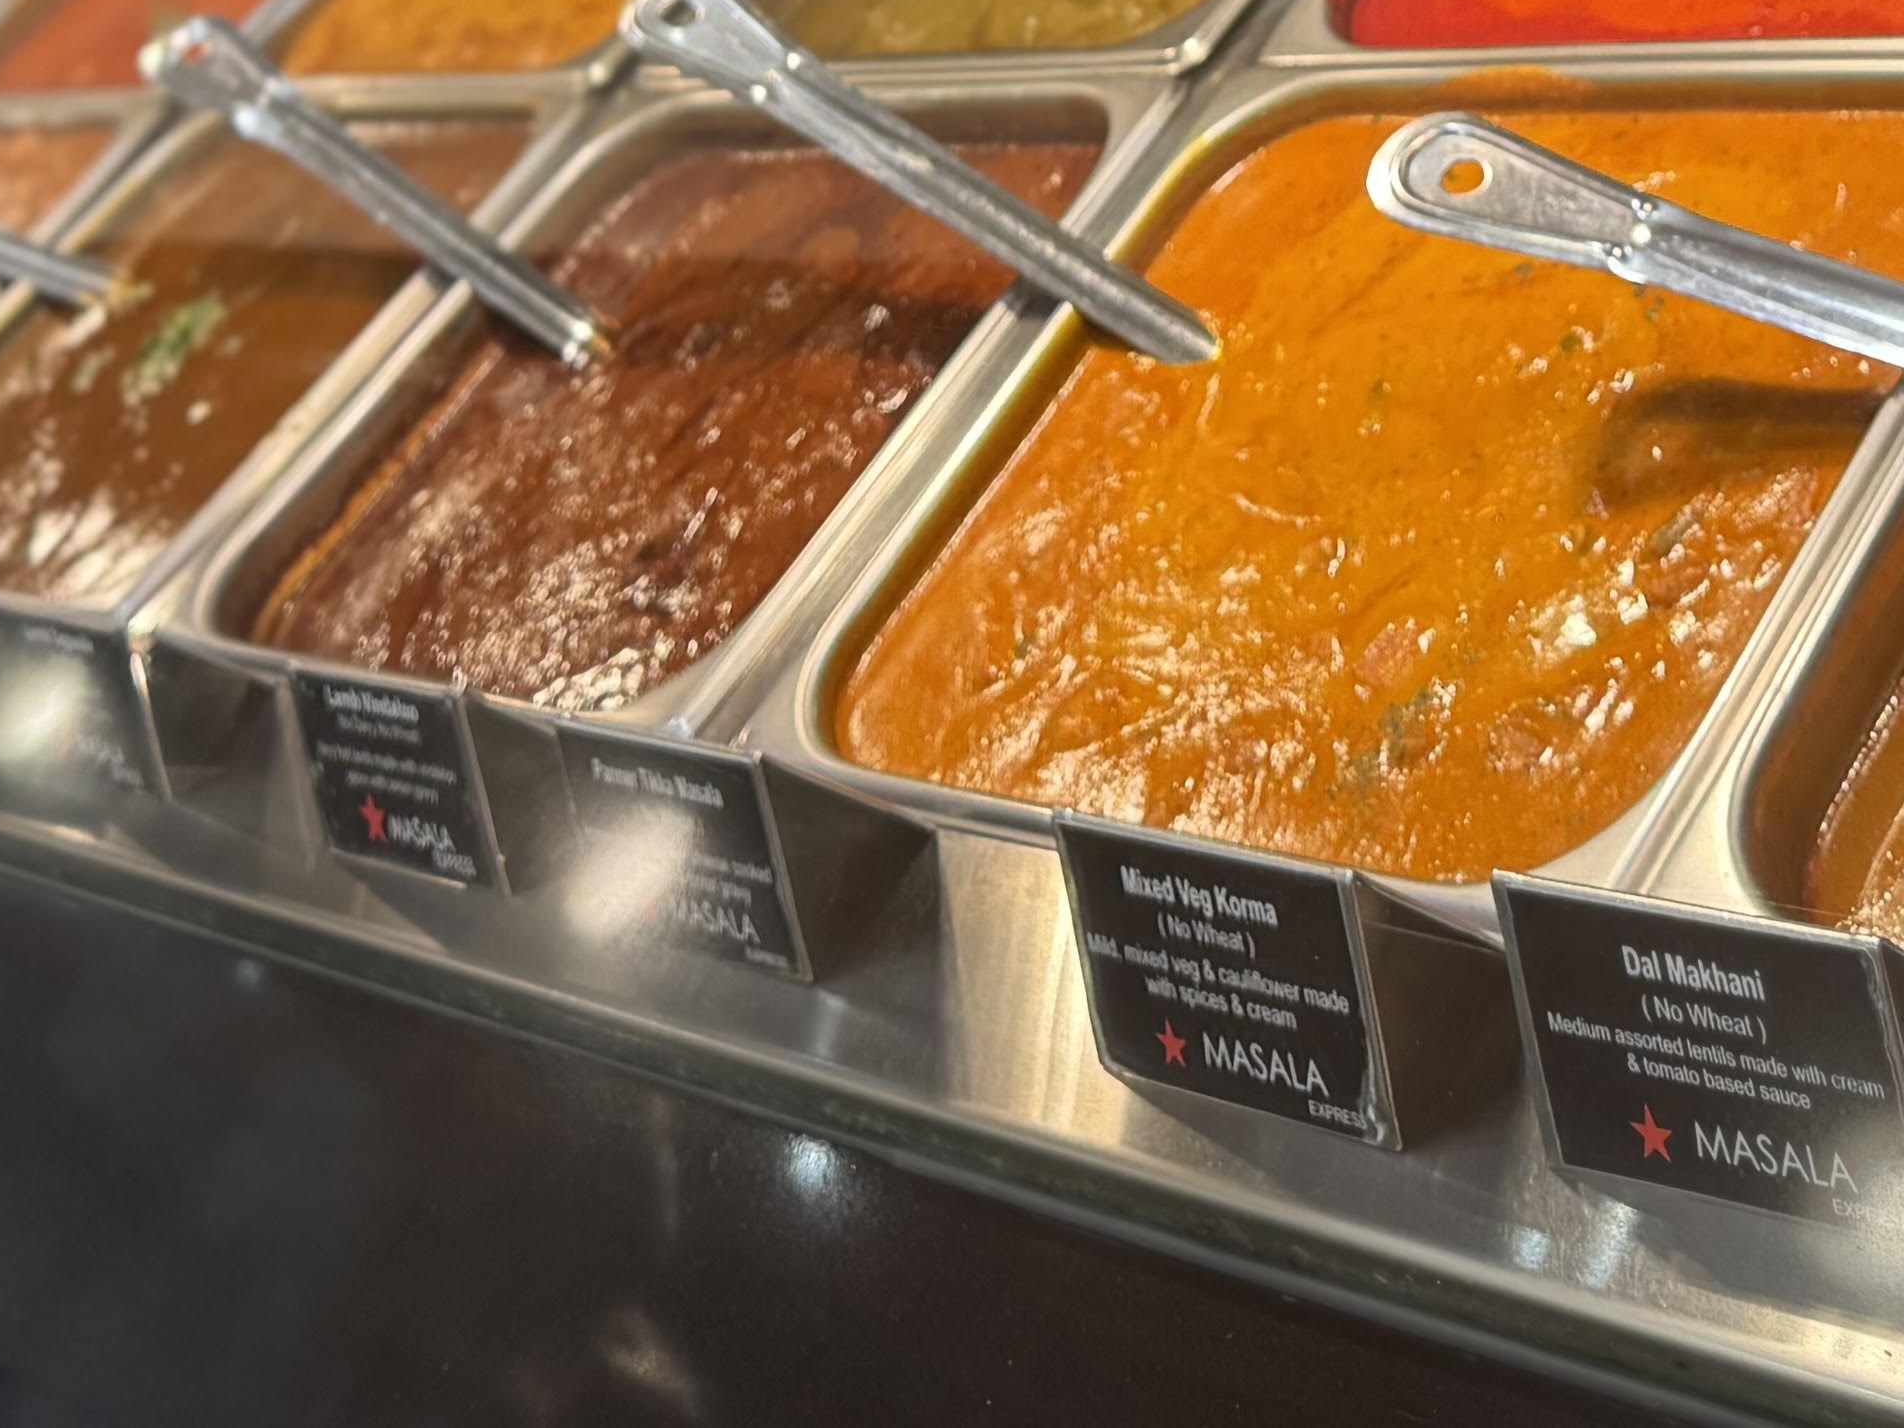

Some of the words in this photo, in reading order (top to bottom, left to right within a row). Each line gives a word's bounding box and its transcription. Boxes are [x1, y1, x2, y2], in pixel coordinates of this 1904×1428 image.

[1121, 864, 1175, 904] Mixed
[1175, 876, 1213, 918] Veg
[1213, 884, 1278, 927] Korma
[1167, 913, 1192, 939] No
[1192, 920, 1245, 952] Wheat
[1123, 942, 1169, 969] mixed
[1171, 955, 1200, 982] veg
[1201, 958, 1216, 982] &
[1217, 964, 1300, 1004] cauliflower
[1302, 984, 1351, 1014] made
[1145, 976, 1178, 1000] with
[1178, 985, 1229, 1013] spices
[1230, 993, 1245, 1017] &
[1245, 1000, 1298, 1029] cream
[1621, 944, 1661, 981] Dal
[1663, 952, 1765, 1001] Makhani
[1653, 994, 1683, 1023] No
[1685, 1001, 1754, 1039] Wheat
[1202, 1031, 1330, 1098] MASALA
[1546, 1010, 1612, 1043] Medium
[1614, 1026, 1685, 1057] assorted
[1686, 1038, 1737, 1068] lentils
[1738, 1051, 1788, 1079] made
[1790, 1063, 1827, 1087] with
[1830, 1071, 1886, 1099] cream
[1626, 1052, 1641, 1073] &
[1643, 1055, 1701, 1087] tomato
[1702, 1070, 1756, 1098] based
[1758, 1083, 1811, 1110] sauce
[1693, 1119, 1860, 1195] MASALA
